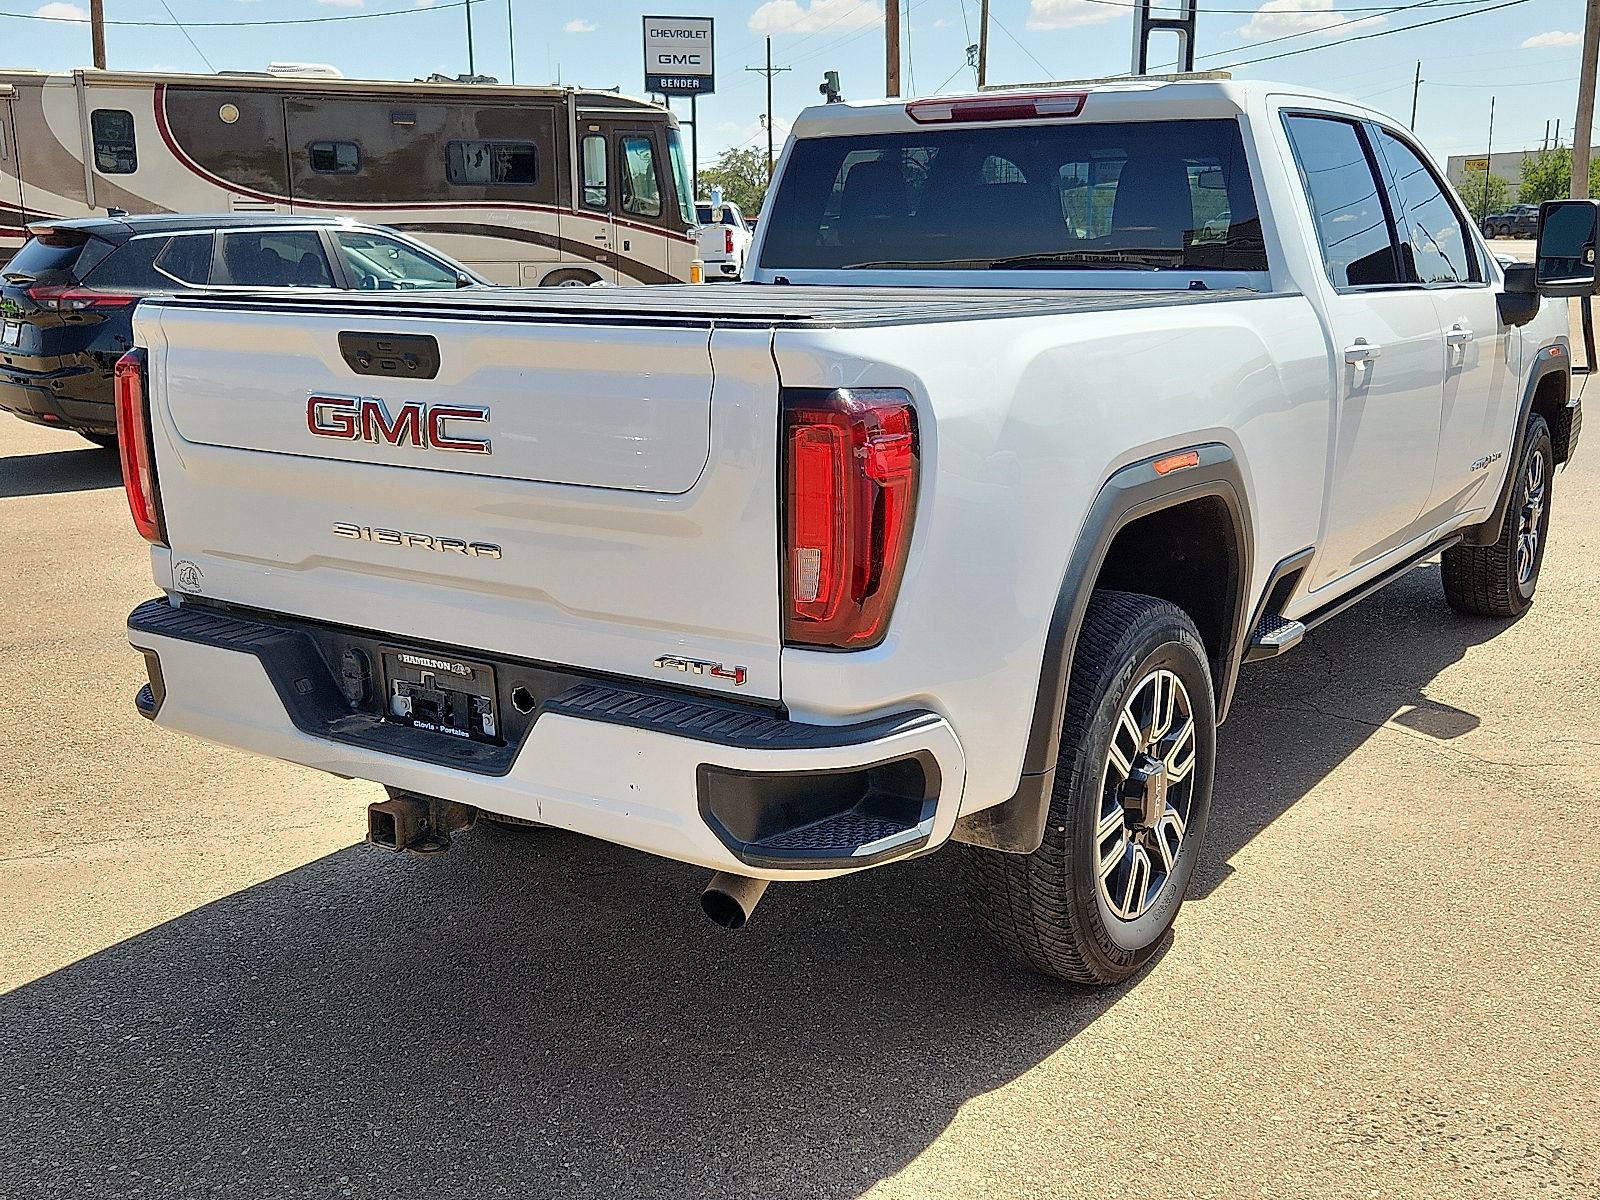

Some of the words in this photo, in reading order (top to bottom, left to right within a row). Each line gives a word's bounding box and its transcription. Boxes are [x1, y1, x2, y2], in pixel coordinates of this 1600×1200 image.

[650, 29, 708, 39] CHEVROLET
[658, 54, 701, 65] GMC
[660, 78, 700, 89] BENDER
[306, 391, 492, 455] GMC
[332, 521, 502, 560] SIERRA
[402, 654, 451, 671] HAMILTON
[653, 653, 748, 687] AT4
[413, 720, 435, 731] Clovis
[439, 725, 470, 738] Portales
